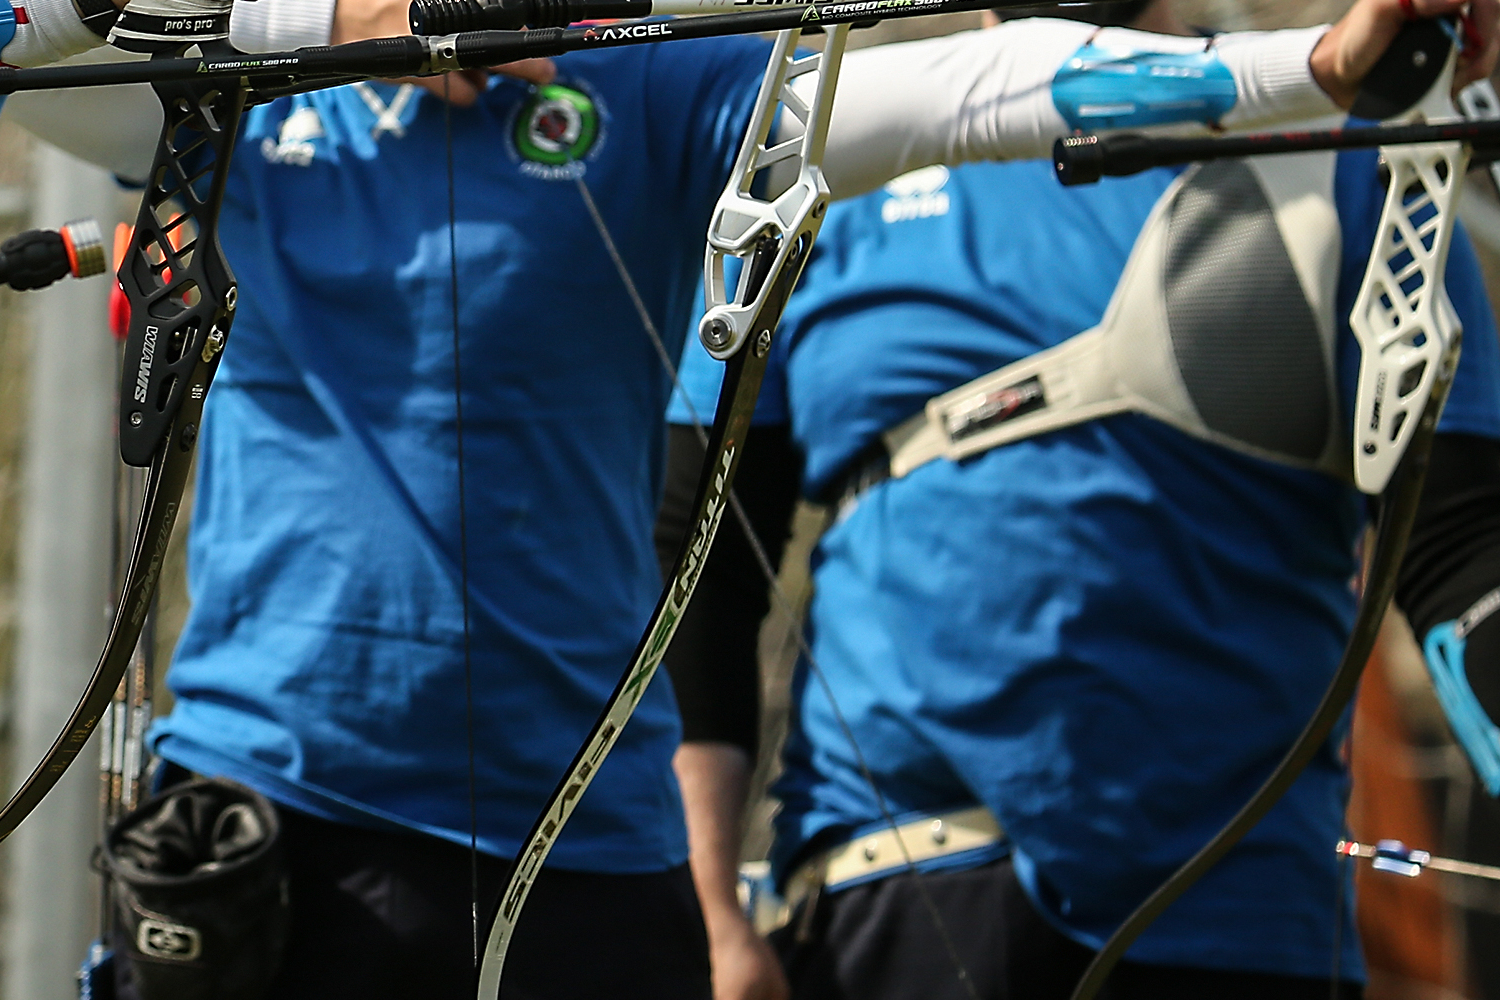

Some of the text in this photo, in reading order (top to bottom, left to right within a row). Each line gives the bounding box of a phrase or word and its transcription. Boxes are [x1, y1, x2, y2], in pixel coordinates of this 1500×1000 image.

[835, 11, 872, 19] COMPOSITE
[897, 3, 943, 12] TECHNOLOGY
[164, 19, 213, 31] pro's pro
[601, 23, 673, 41] AXCEL
[134, 325, 159, 404] WIAWIS
[503, 719, 617, 925] FIVICS
